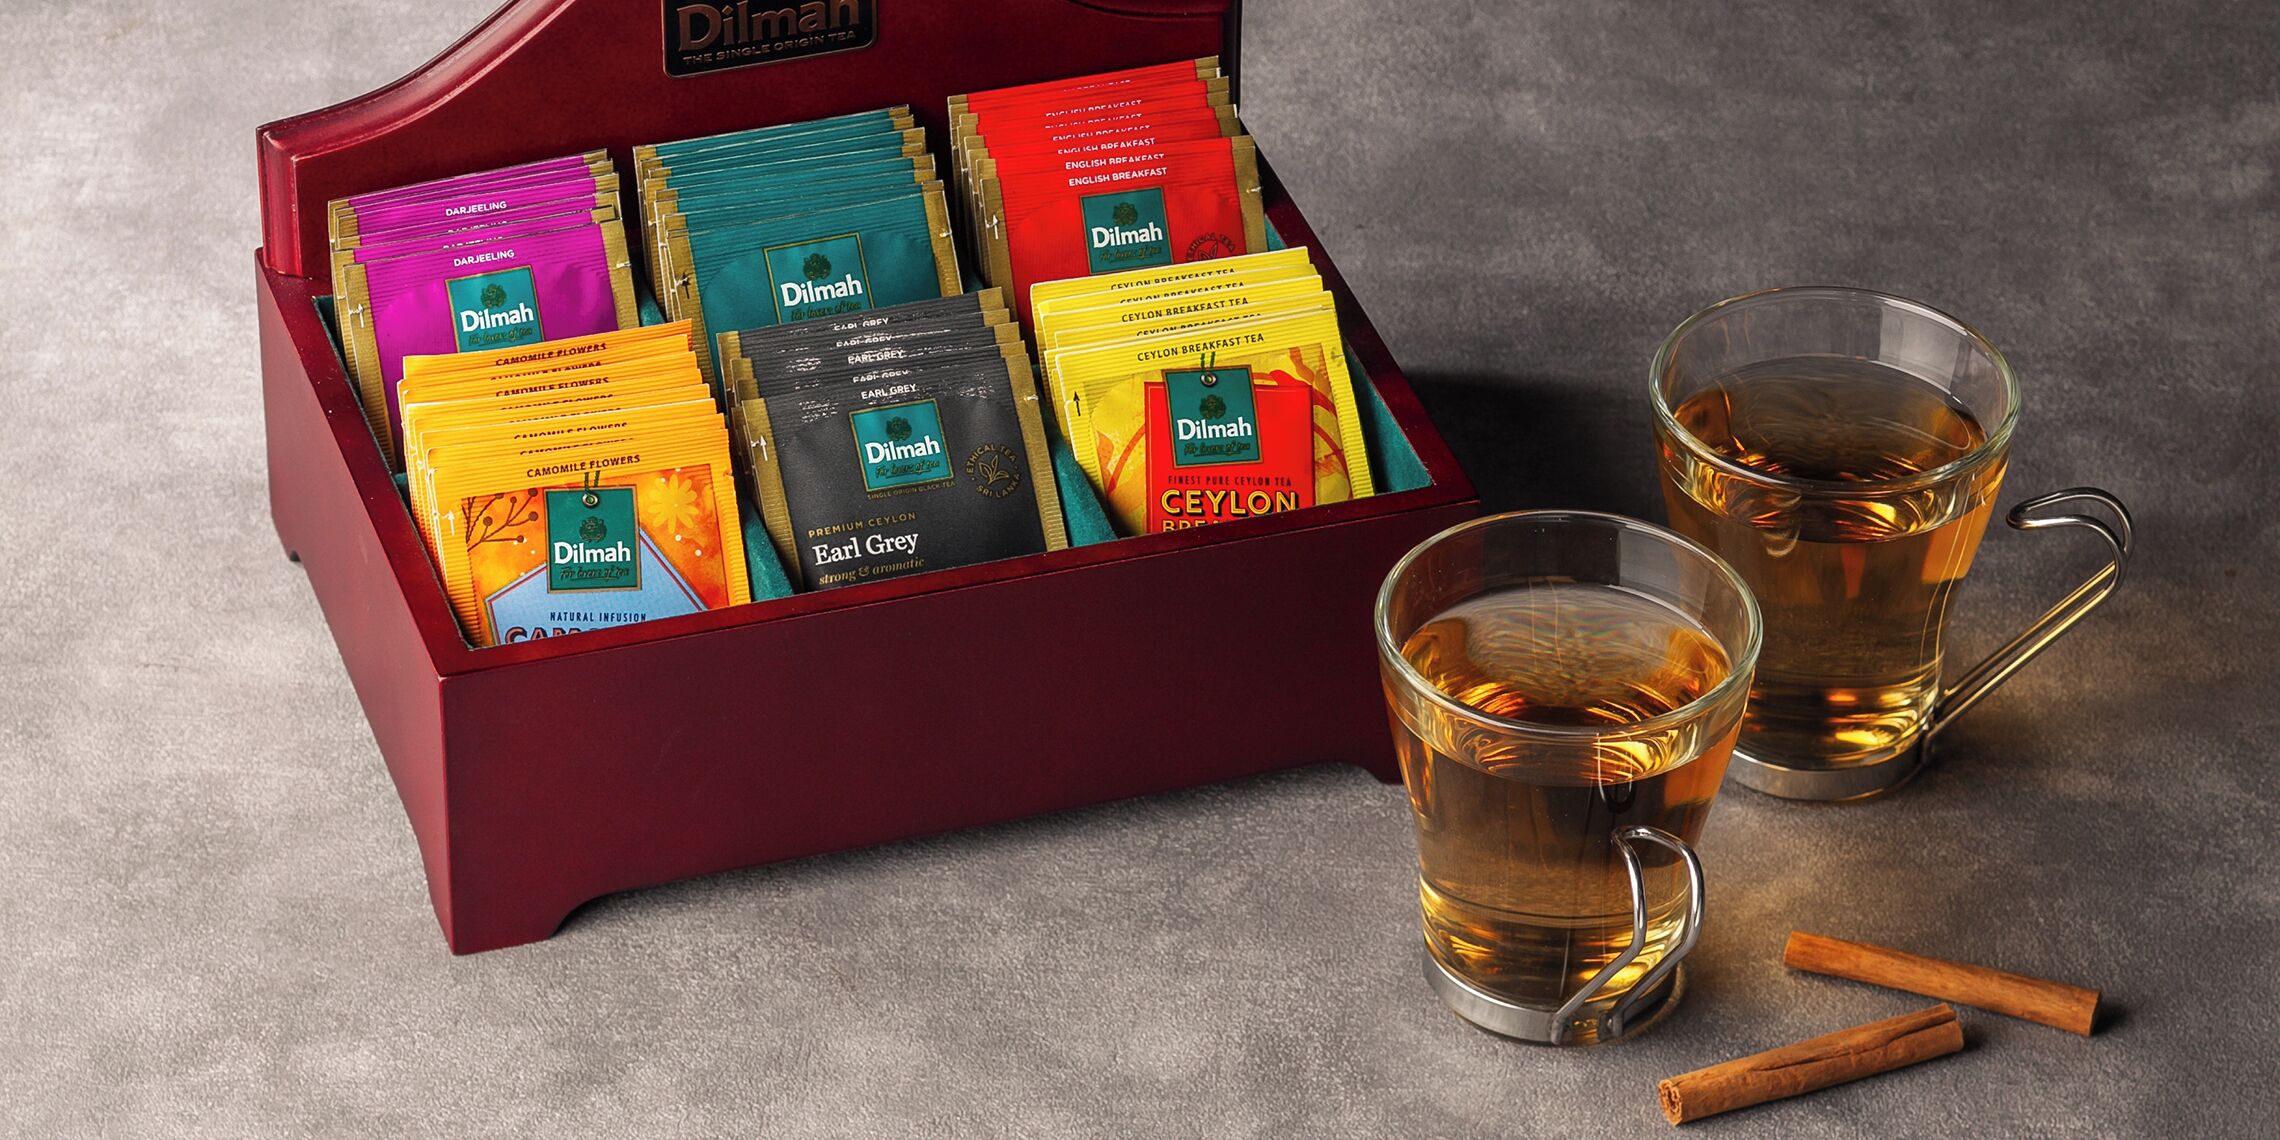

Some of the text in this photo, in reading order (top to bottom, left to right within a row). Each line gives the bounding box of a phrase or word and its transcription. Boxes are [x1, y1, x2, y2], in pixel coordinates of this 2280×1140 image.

[676, 0, 860, 51] Dilmah
[683, 30, 856, 65] THE SINGLE ORIGIN TEA
[1065, 156, 1106, 170] ENGLISH
[1068, 167, 1167, 187] ENGLISH BREAKFAST
[445, 201, 507, 216] DARJEELING
[1091, 222, 1163, 248] Dilmah
[453, 249, 515, 267] DARJEELING
[780, 273, 863, 307] Dilmah
[460, 302, 535, 332] Dilmah
[1121, 297, 1249, 323] CEYLON BREAKFAST TEA
[495, 343, 607, 366] CAMOMILE FLOWERS
[847, 349, 903, 365] EARL GREY
[1137, 333, 1264, 362] CEYLON BREAKFAST TEA
[860, 383, 917, 400] EARL GREY
[1177, 416, 1252, 440] Dilmah
[865, 435, 941, 464] Dilmah
[966, 444, 1017, 474] ETHICAL TEA
[526, 454, 641, 478] CAMOMILE FLOWERS
[976, 473, 1022, 498] SRI LANKA
[1168, 475, 1292, 487] FINEST PURE CEYLON TEA
[866, 492, 892, 501] SINGLE
[894, 487, 917, 497] ORIGIN
[1161, 489, 1298, 517] CEYLON
[808, 512, 917, 538] PREMIUM CEYLON
[553, 541, 631, 565] Dilmah
[812, 533, 919, 566] Earl Grey
[818, 556, 925, 586] strong & aromatic
[550, 611, 647, 623] NATURAL INFUSION
